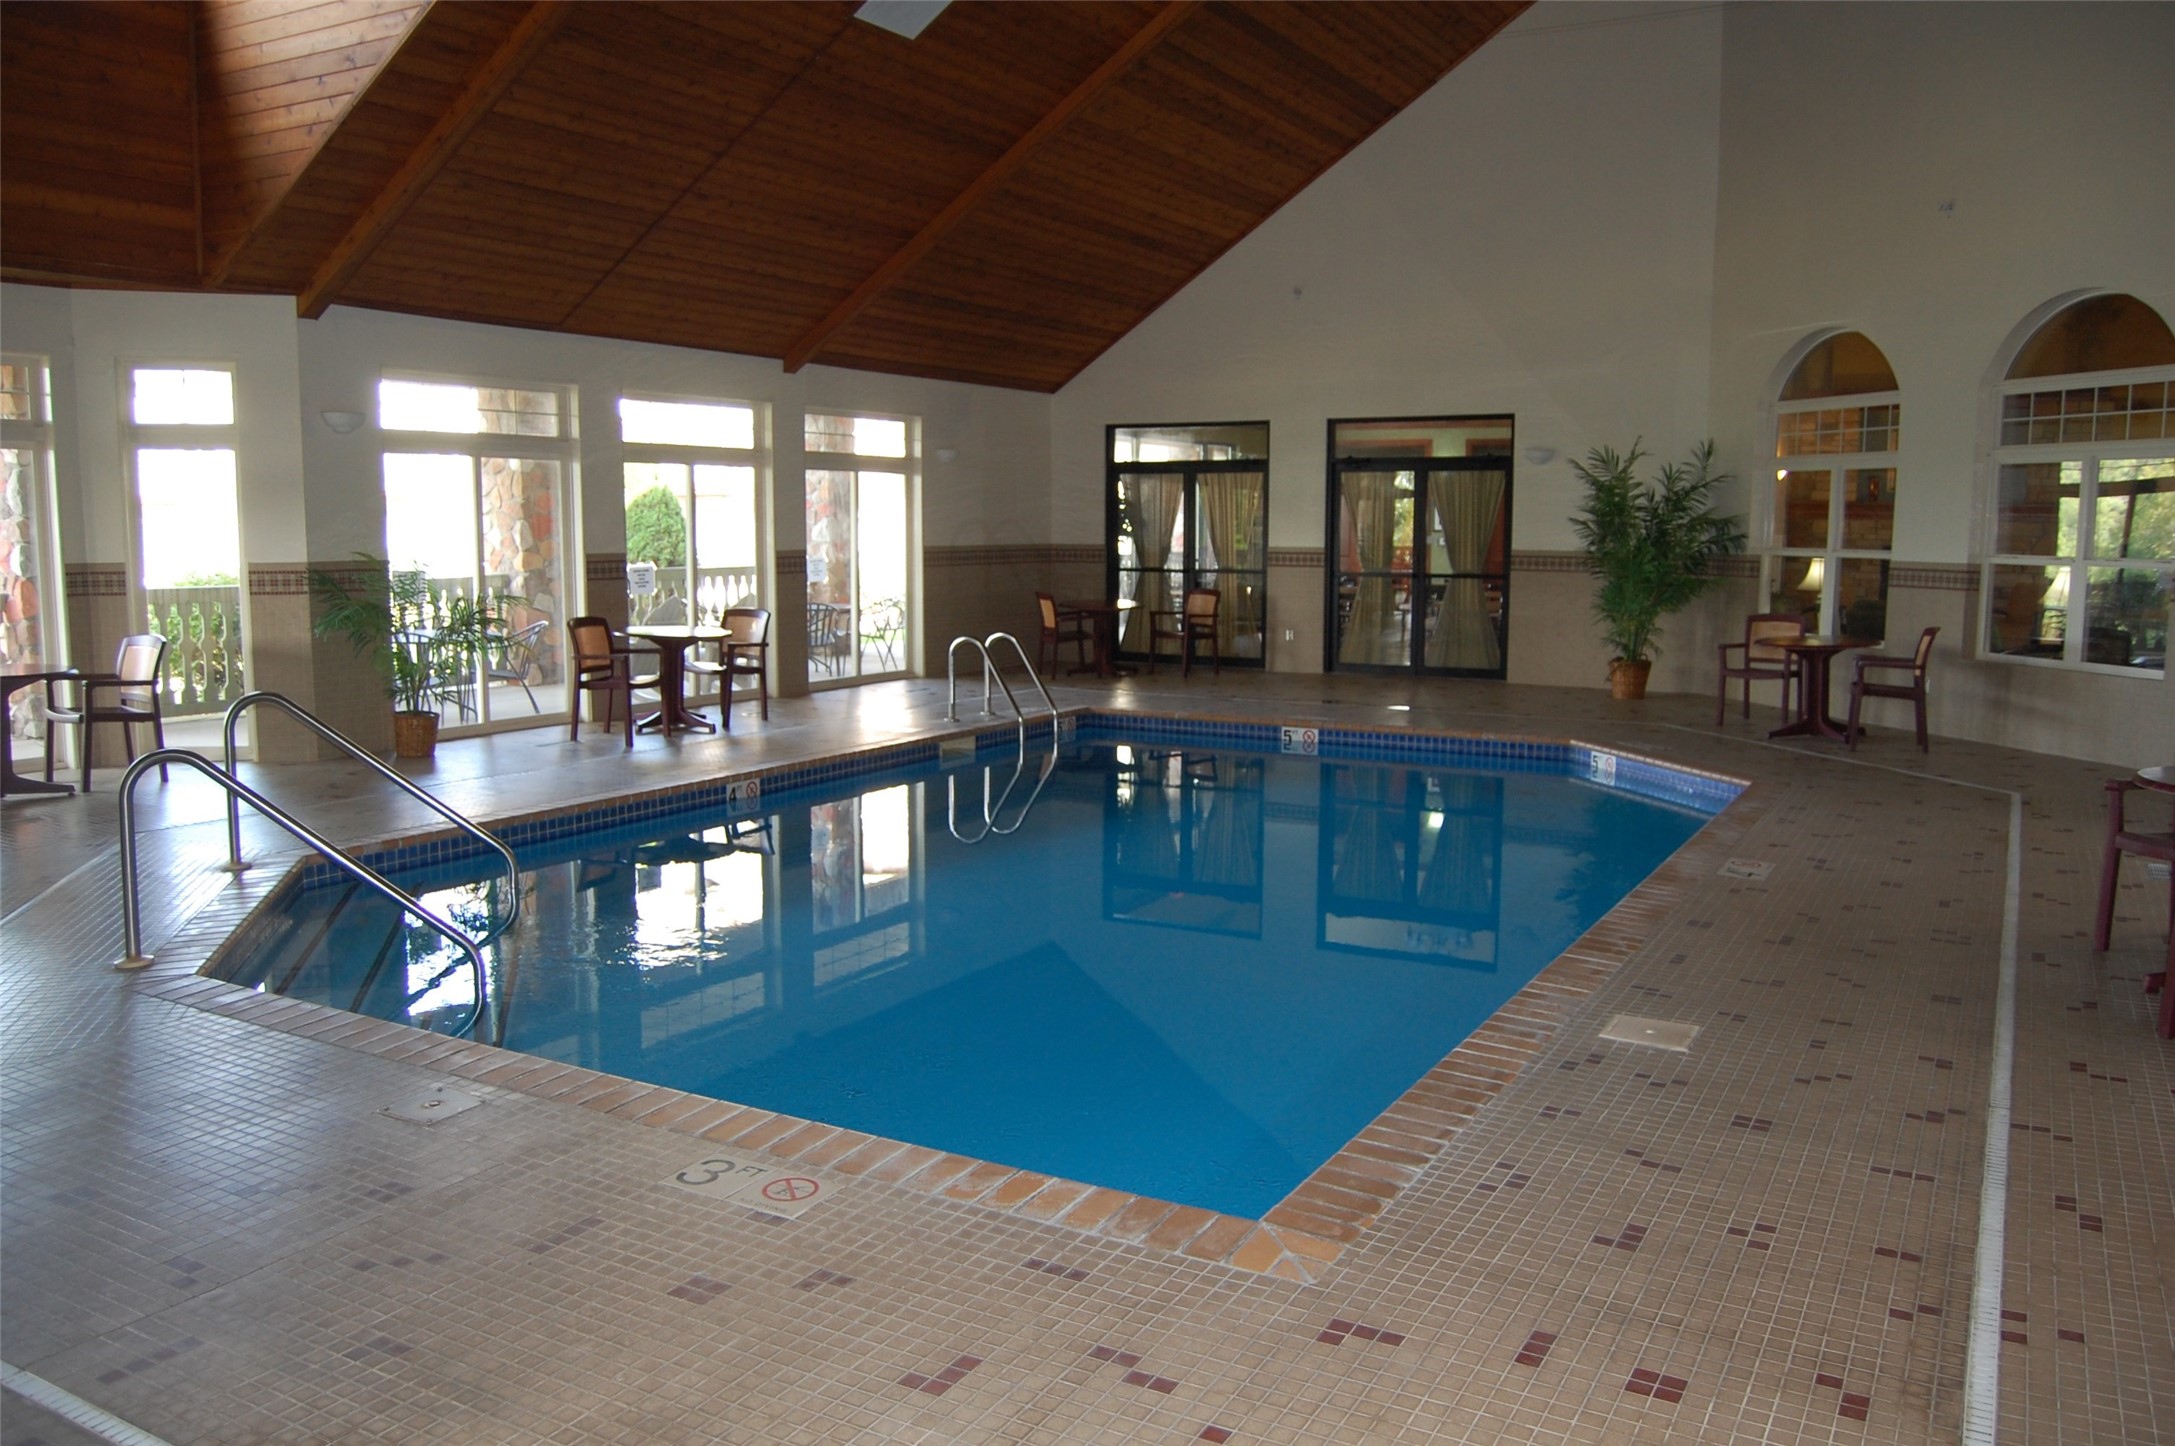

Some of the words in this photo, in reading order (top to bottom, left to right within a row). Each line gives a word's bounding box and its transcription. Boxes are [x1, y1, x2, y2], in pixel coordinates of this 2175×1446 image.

[1283, 729, 1292, 743] 5
[728, 786, 736, 801] 4
[676, 1159, 736, 1186] 3
[735, 1165, 768, 1178] FT
